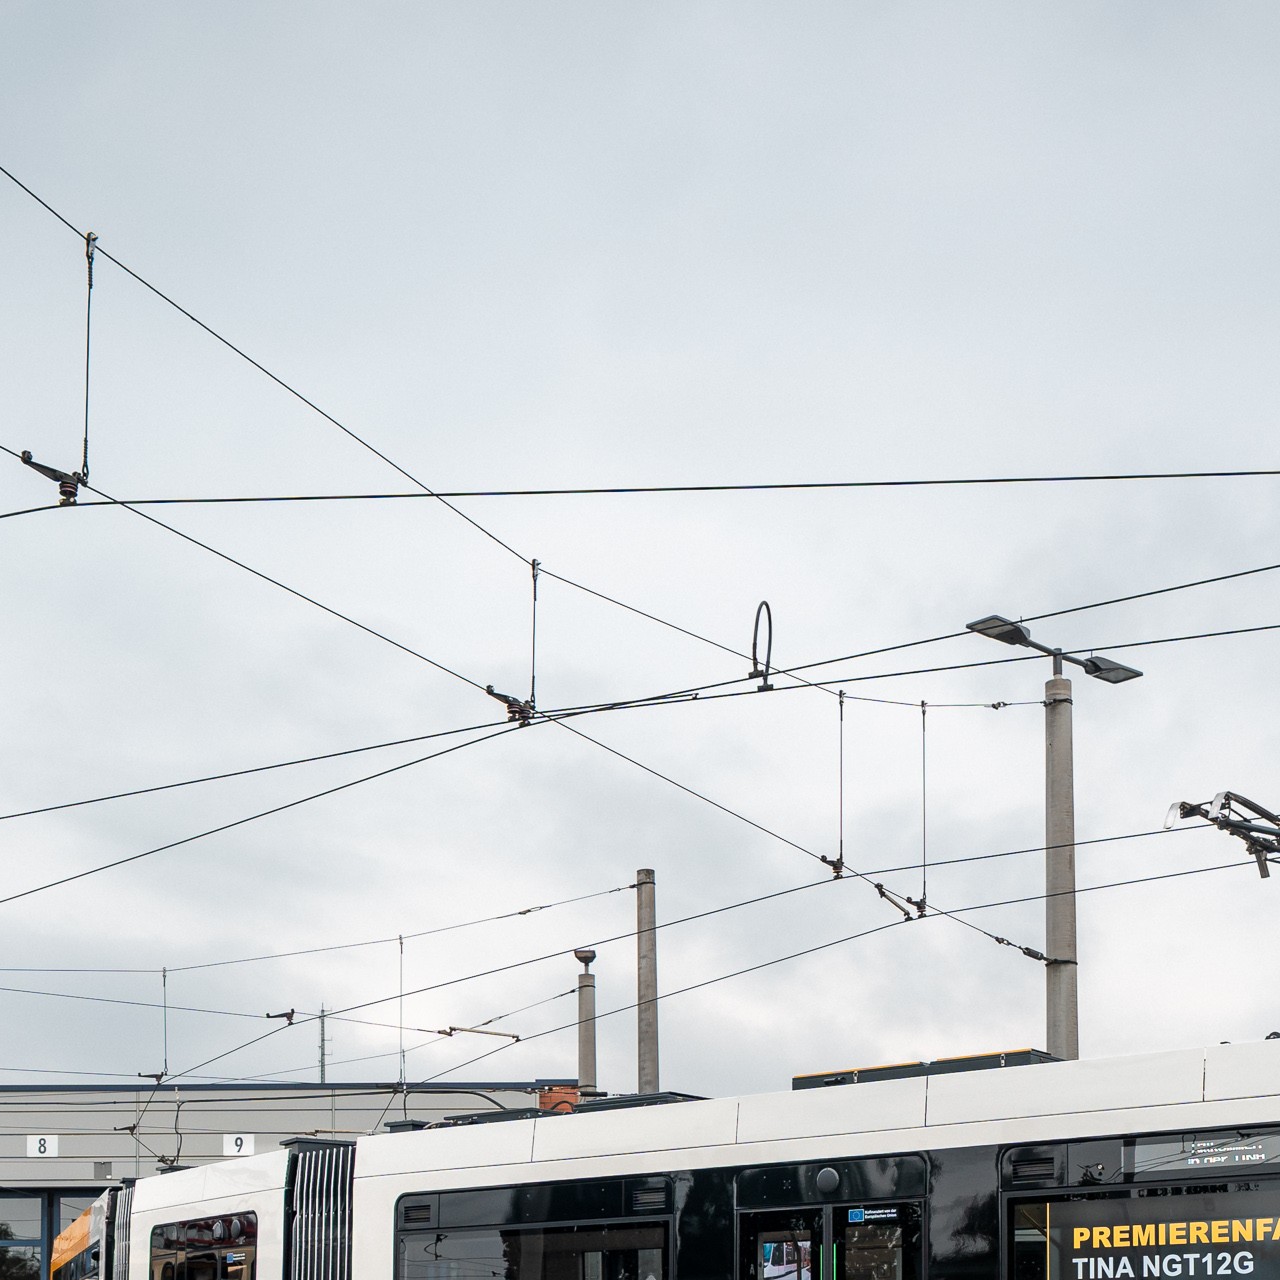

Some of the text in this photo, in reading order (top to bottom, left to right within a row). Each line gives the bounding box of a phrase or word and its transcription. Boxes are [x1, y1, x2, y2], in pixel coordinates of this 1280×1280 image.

[38, 1138, 47, 1154] 8
[234, 1137, 243, 1153] 9
[1072, 1251, 1255, 1279] TINA NGT12G
